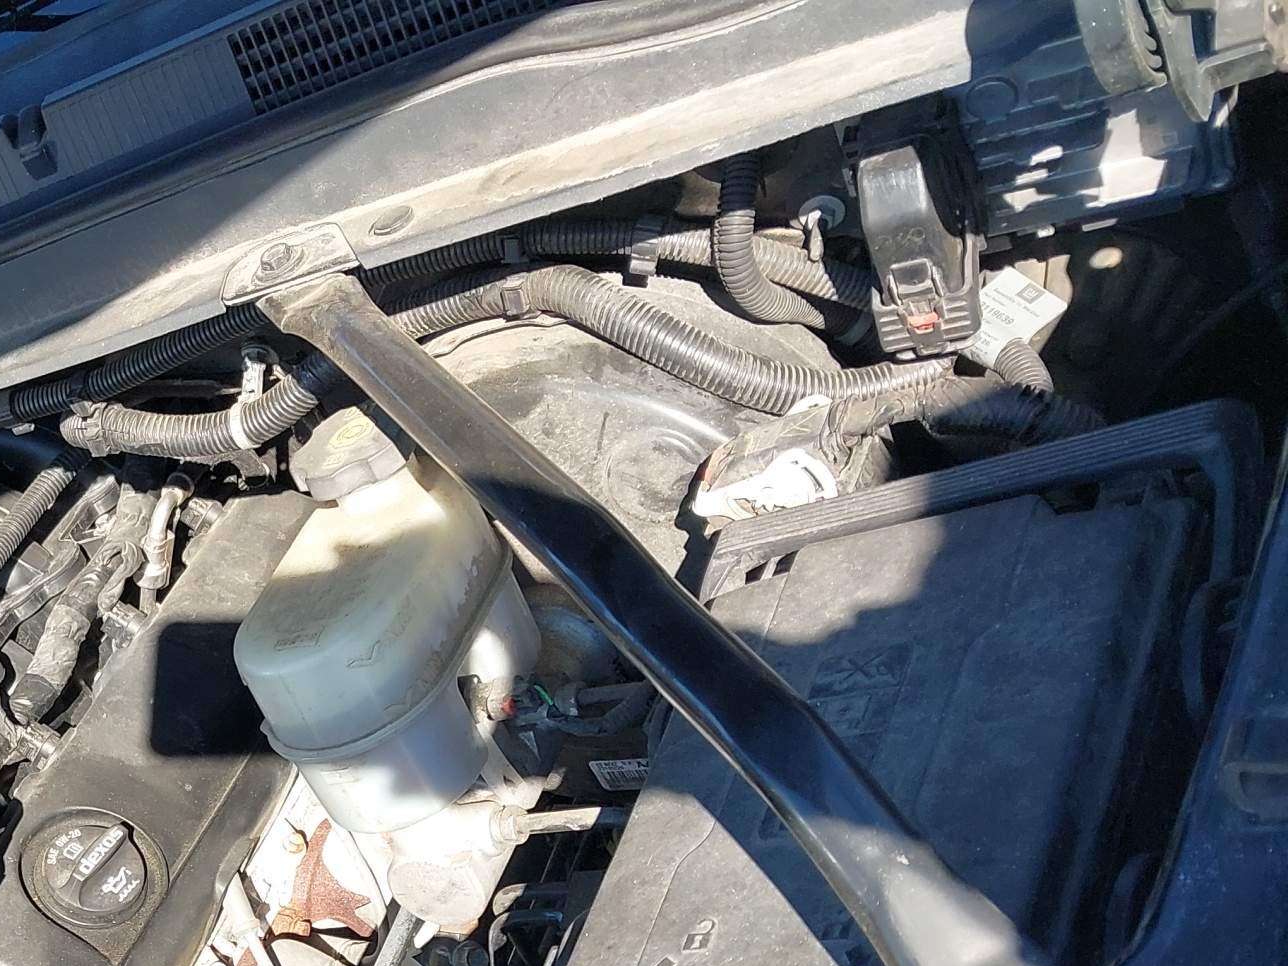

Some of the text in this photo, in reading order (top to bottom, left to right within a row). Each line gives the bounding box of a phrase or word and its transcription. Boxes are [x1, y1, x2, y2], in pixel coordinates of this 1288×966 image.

[46, 829, 81, 865] SAE 0W-20
[78, 826, 124, 876] dexos
